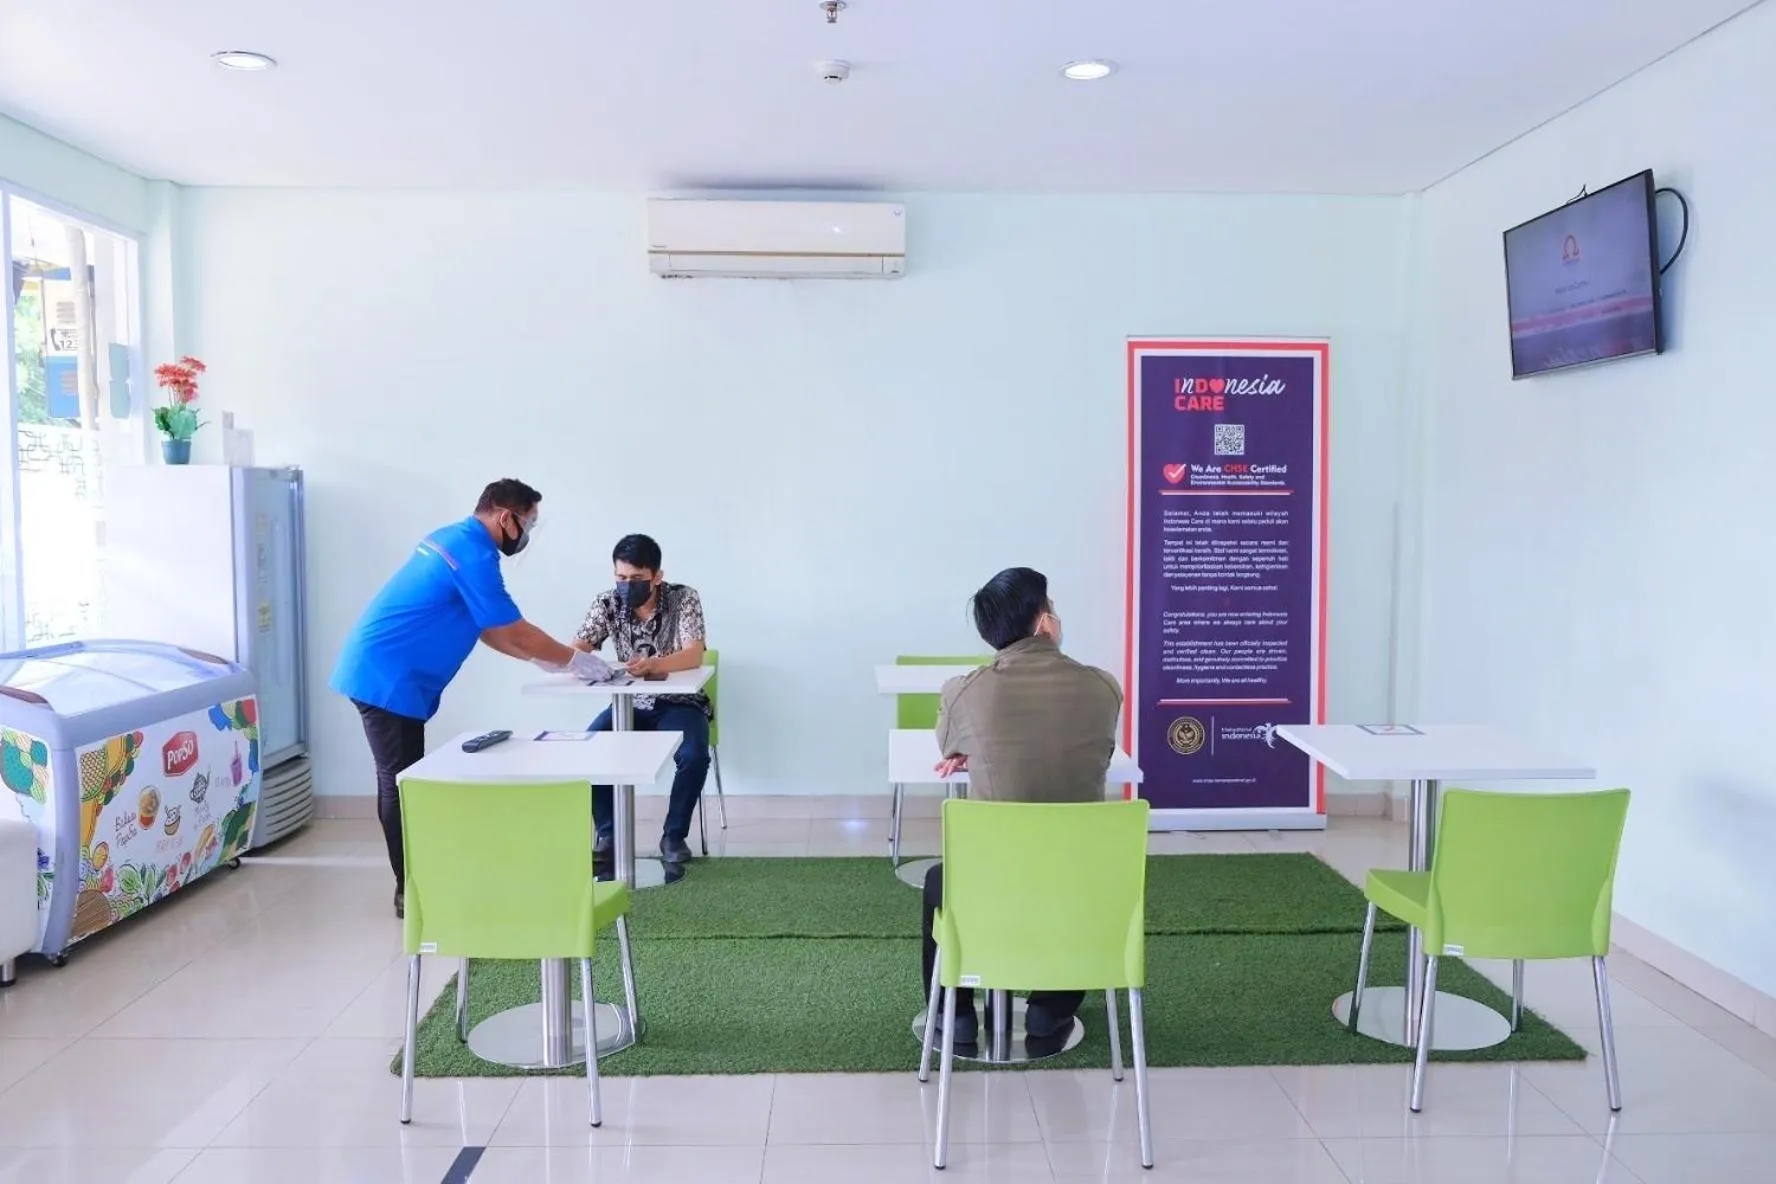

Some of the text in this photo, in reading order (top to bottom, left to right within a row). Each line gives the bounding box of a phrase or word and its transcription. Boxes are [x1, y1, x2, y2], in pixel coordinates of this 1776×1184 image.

[1174, 396, 1225, 411] CARE
[1191, 464, 1287, 473] We Are CHSE Certified
